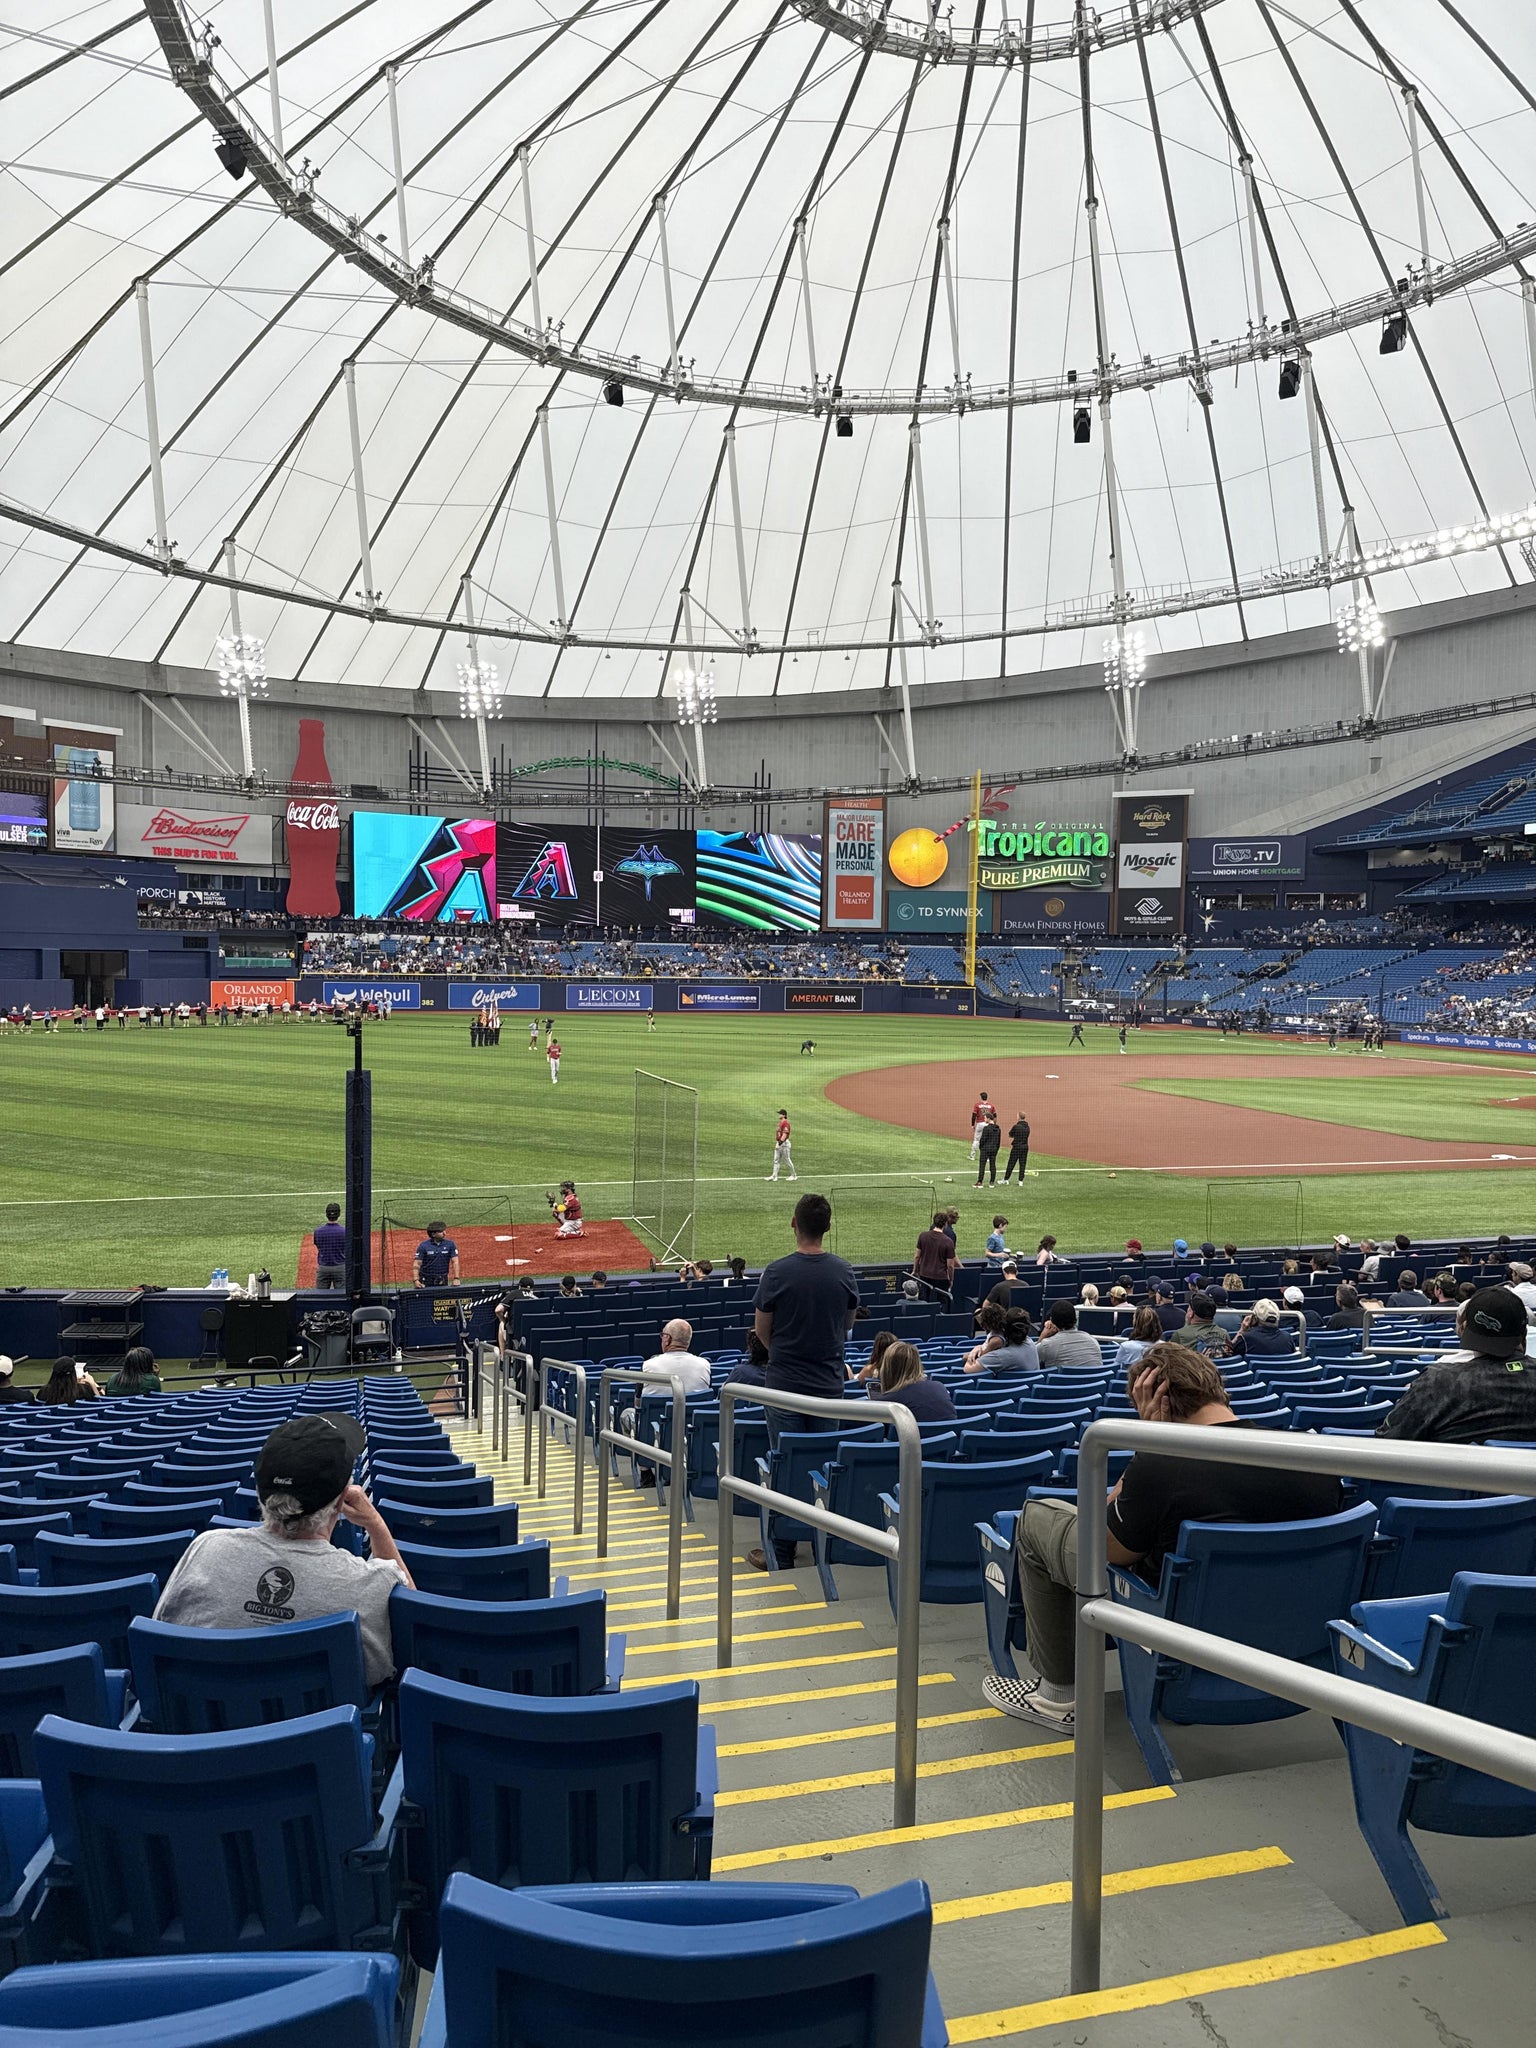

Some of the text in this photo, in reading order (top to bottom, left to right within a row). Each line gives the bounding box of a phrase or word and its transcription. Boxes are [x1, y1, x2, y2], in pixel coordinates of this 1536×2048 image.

[287, 801, 340, 830] Coca-Cola
[1133, 811, 1171, 821] Hard Rock
[11, 825, 27, 833] COLE
[151, 816, 238, 838] Budweiser
[836, 822, 875, 842] CARE
[967, 819, 1110, 861] Tropicana
[152, 847, 239, 861] THIS BUD'S FOR YOU.
[836, 842, 875, 860] MADE
[836, 860, 875, 871] PERSONAL
[1123, 853, 1177, 867] Mosaic
[981, 863, 1090, 885] PURE PREMIUM
[140, 888, 176, 899] PORCH
[839, 890, 871, 898] ORLANDO
[918, 907, 983, 917] TD SYNNEX
[1004, 920, 1105, 930] DREAM FINDERS HOMES
[223, 984, 283, 995] ORLANDO
[360, 988, 411, 1002] Webull
[472, 986, 518, 1007] Culver's
[791, 995, 856, 1003] AMERANT BANK
[1407, 1033, 1429, 1041] Spectrum
[1435, 1035, 1458, 1043] Spectrum
[1464, 1037, 1488, 1046] Spectrum
[1494, 1040, 1520, 1048] Spectrum
[246, 1602, 293, 1618] BIG TONY'S
[1348, 1639, 1356, 1664] X
